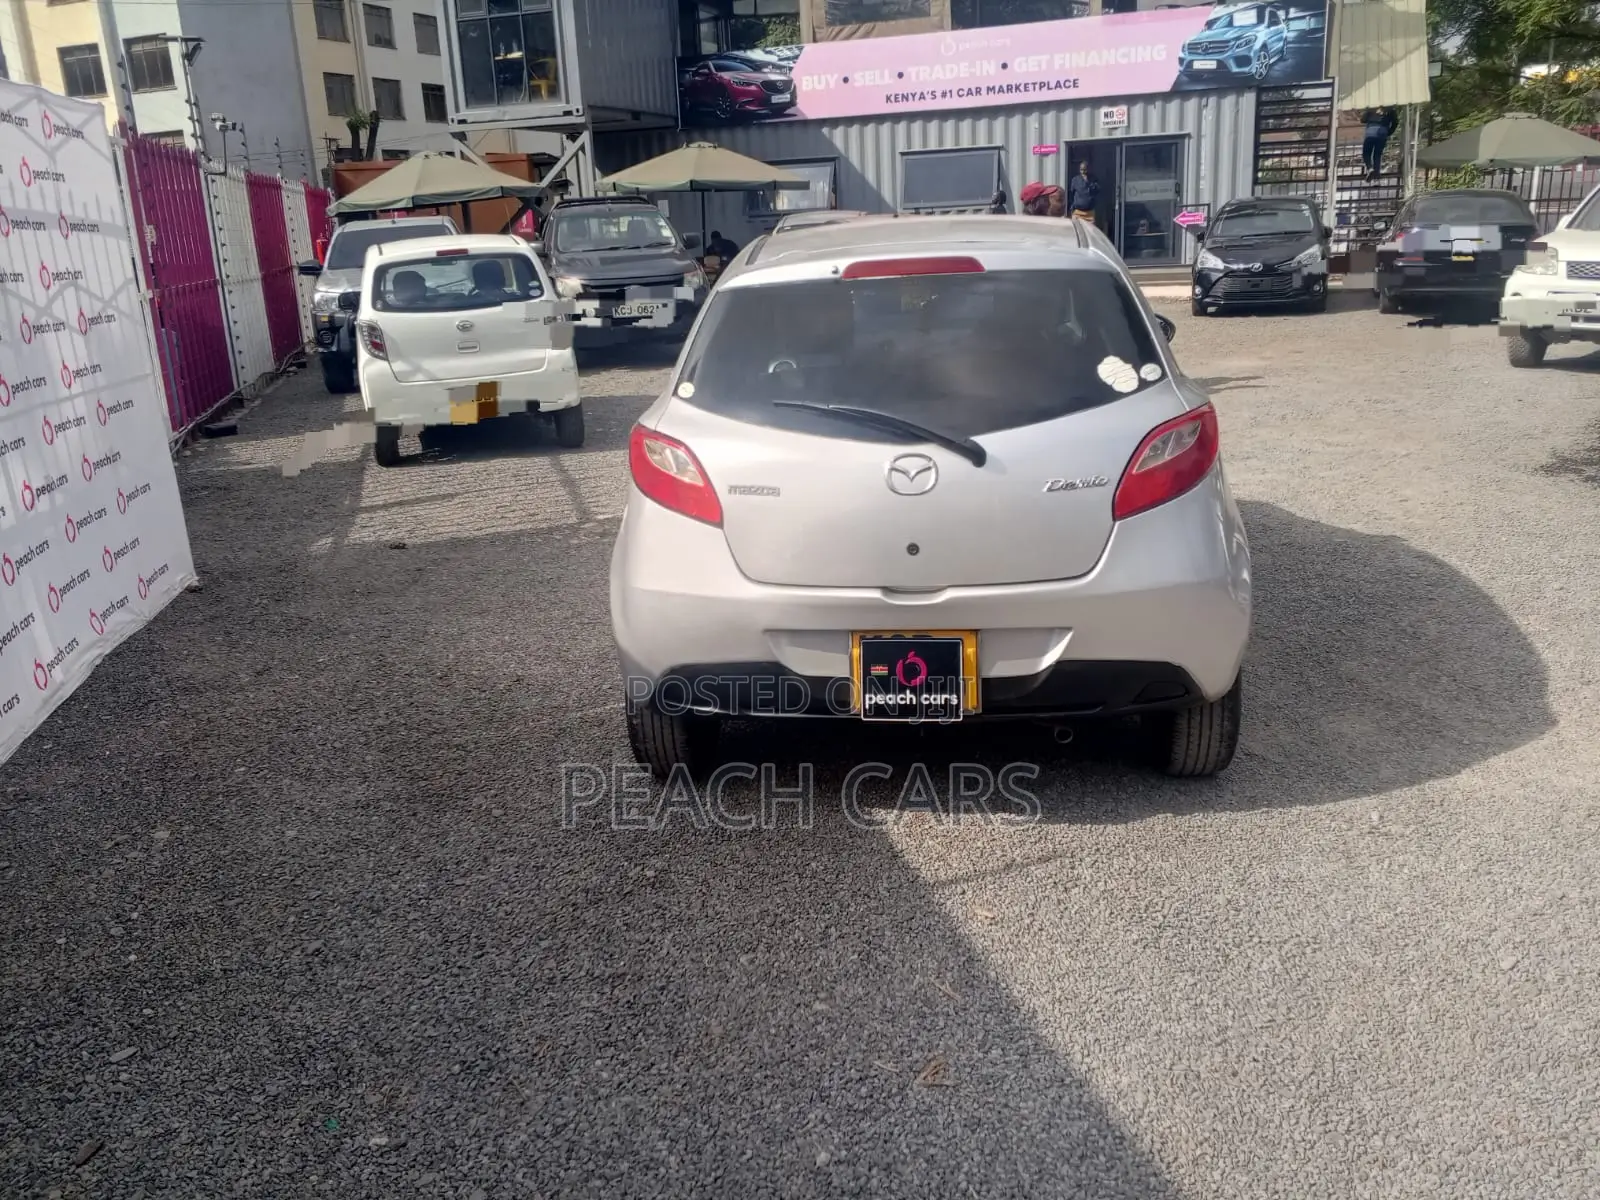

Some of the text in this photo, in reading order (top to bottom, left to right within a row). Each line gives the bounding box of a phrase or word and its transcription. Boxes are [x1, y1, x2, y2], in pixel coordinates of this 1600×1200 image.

[802, 44, 1167, 91] BUY SELL TRADE-IN GET FINANCING
[885, 78, 1080, 104] KENYA'S #1 CAR MARKETPLACE
[1103, 110, 1114, 119] NO
[11, 216, 46, 234] peach cars
[69, 220, 99, 235] peach cars
[33, 320, 65, 338] peach cars
[72, 362, 102, 383] peach cars
[11, 376, 47, 400] peach cars
[54, 416, 86, 438] peach cars
[10, 436, 26, 451] cars
[92, 453, 111, 475] peach
[76, 506, 108, 535] peach cars
[15, 539, 50, 575] peach cars
[113, 542, 130, 566] peach
[59, 568, 91, 602] peach cars
[100, 594, 129, 625] peach cars
[19, 612, 35, 631] cars
[46, 637, 80, 678] peach cars
[2, 694, 20, 714] cars
[865, 689, 958, 710] peach cars
